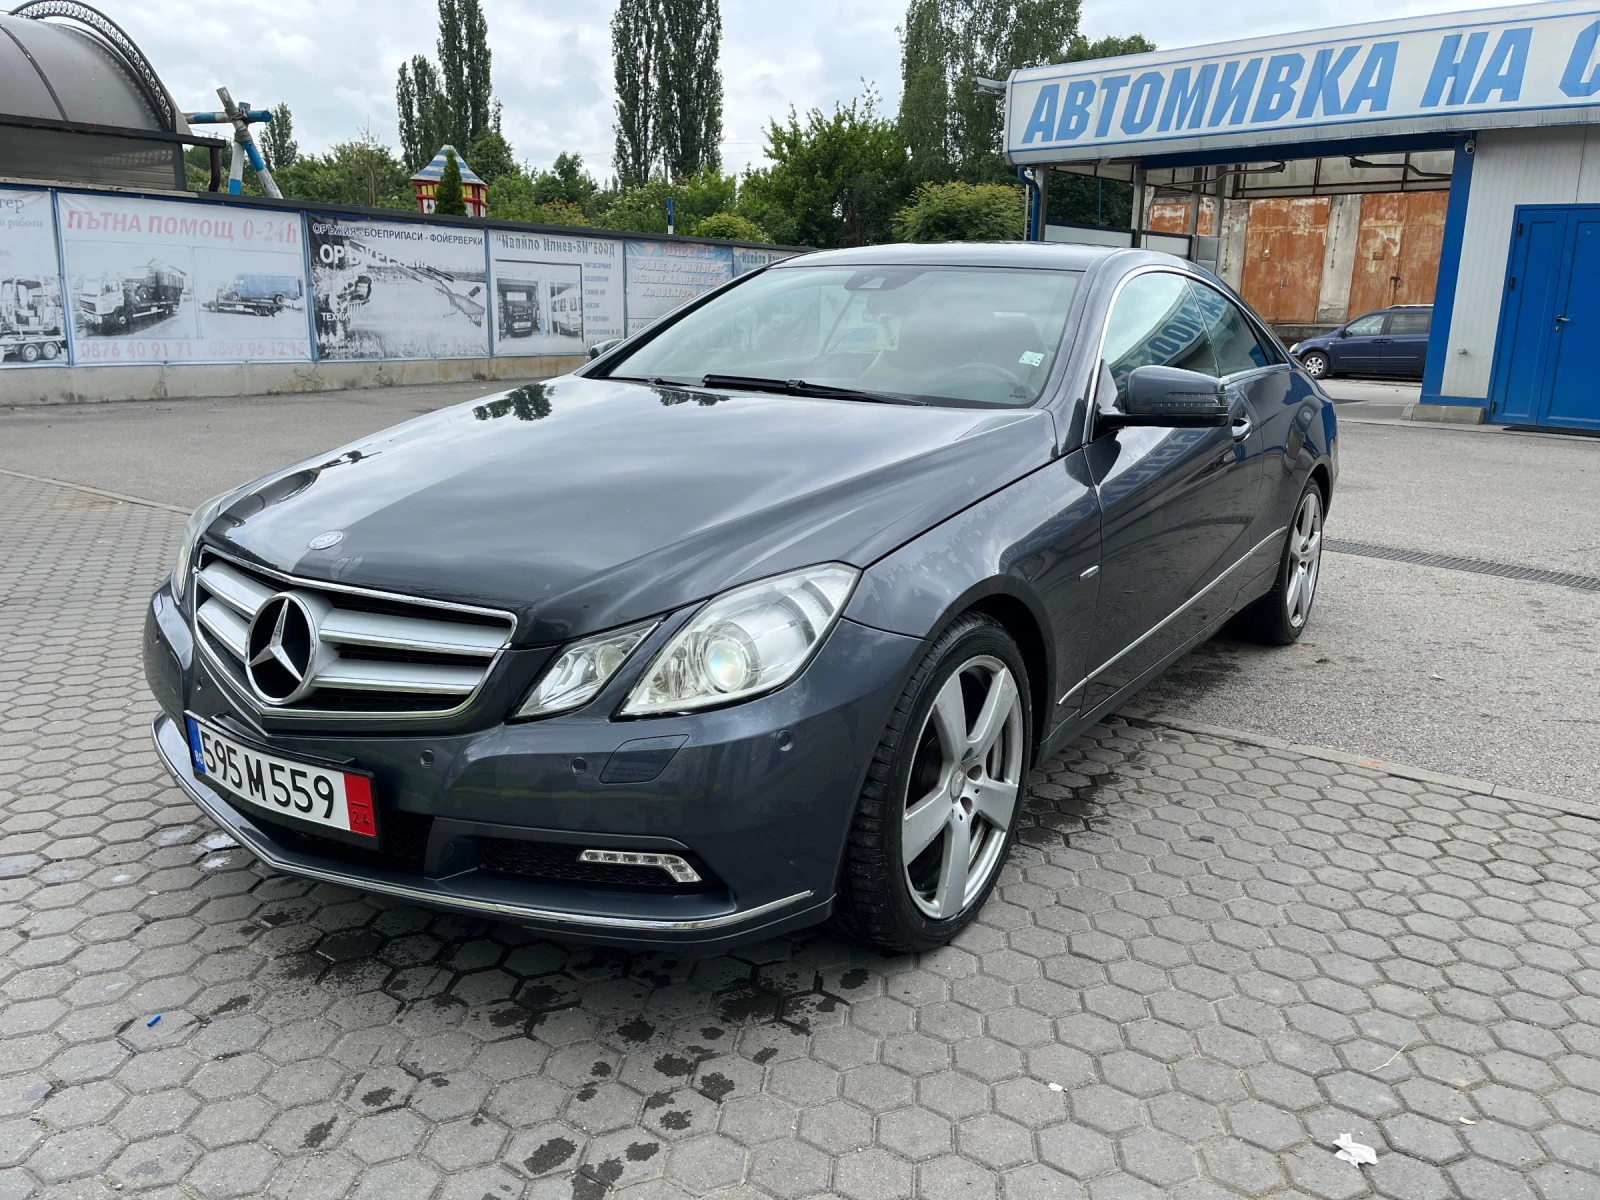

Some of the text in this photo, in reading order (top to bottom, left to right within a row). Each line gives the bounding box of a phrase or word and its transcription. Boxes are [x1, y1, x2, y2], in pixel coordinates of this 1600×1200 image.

[1021, 40, 1399, 144] АВТОМИВКА
[1419, 27, 1533, 107] НА
[68, 210, 297, 243] ПЪТНА ПОМОЩ 0-24h
[312, 223, 356, 236] ОРЪЖИЯ
[364, 228, 423, 241] БОЕПРИПАСИ
[429, 233, 483, 246] ФОЙЕРВЕРКИ
[81, 342, 121, 359] 0876
[126, 342, 145, 358] 40
[152, 342, 169, 358] 91
[352, 810, 370, 825] 24
